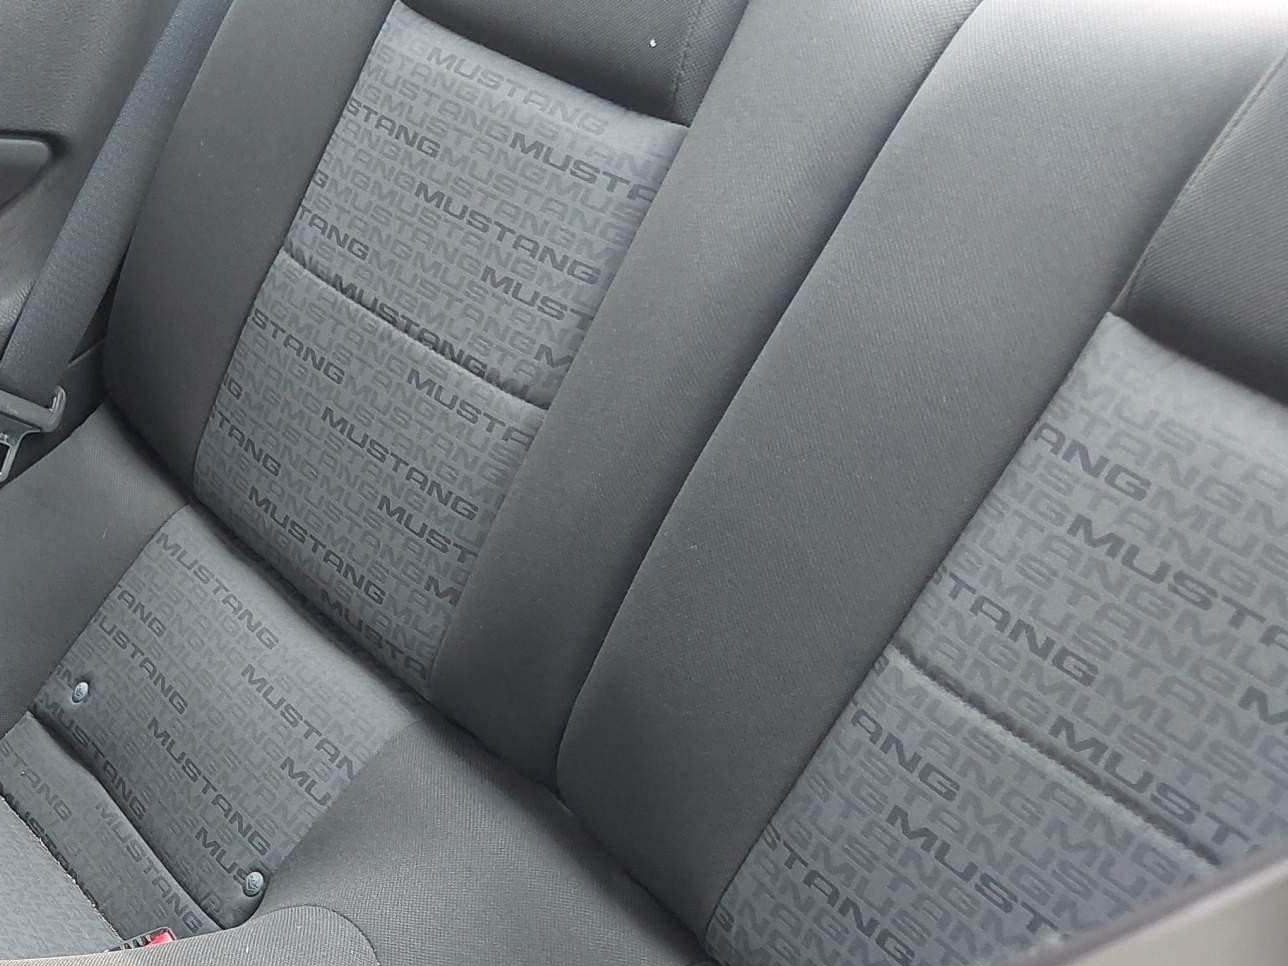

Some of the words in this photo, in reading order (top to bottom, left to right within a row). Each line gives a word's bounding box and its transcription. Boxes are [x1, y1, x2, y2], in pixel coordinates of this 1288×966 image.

[426, 46, 609, 136] MUSTANG
[415, 181, 601, 285] MUSTANG
[252, 308, 345, 385] STANG
[320, 406, 478, 521] MUSTANG
[155, 532, 280, 650] MUSTANG
[248, 485, 387, 606] MUSTANG
[39, 695, 147, 822] MUSTANG
[147, 716, 271, 856] MUSTANG
[95, 800, 203, 934] MUSTANG
